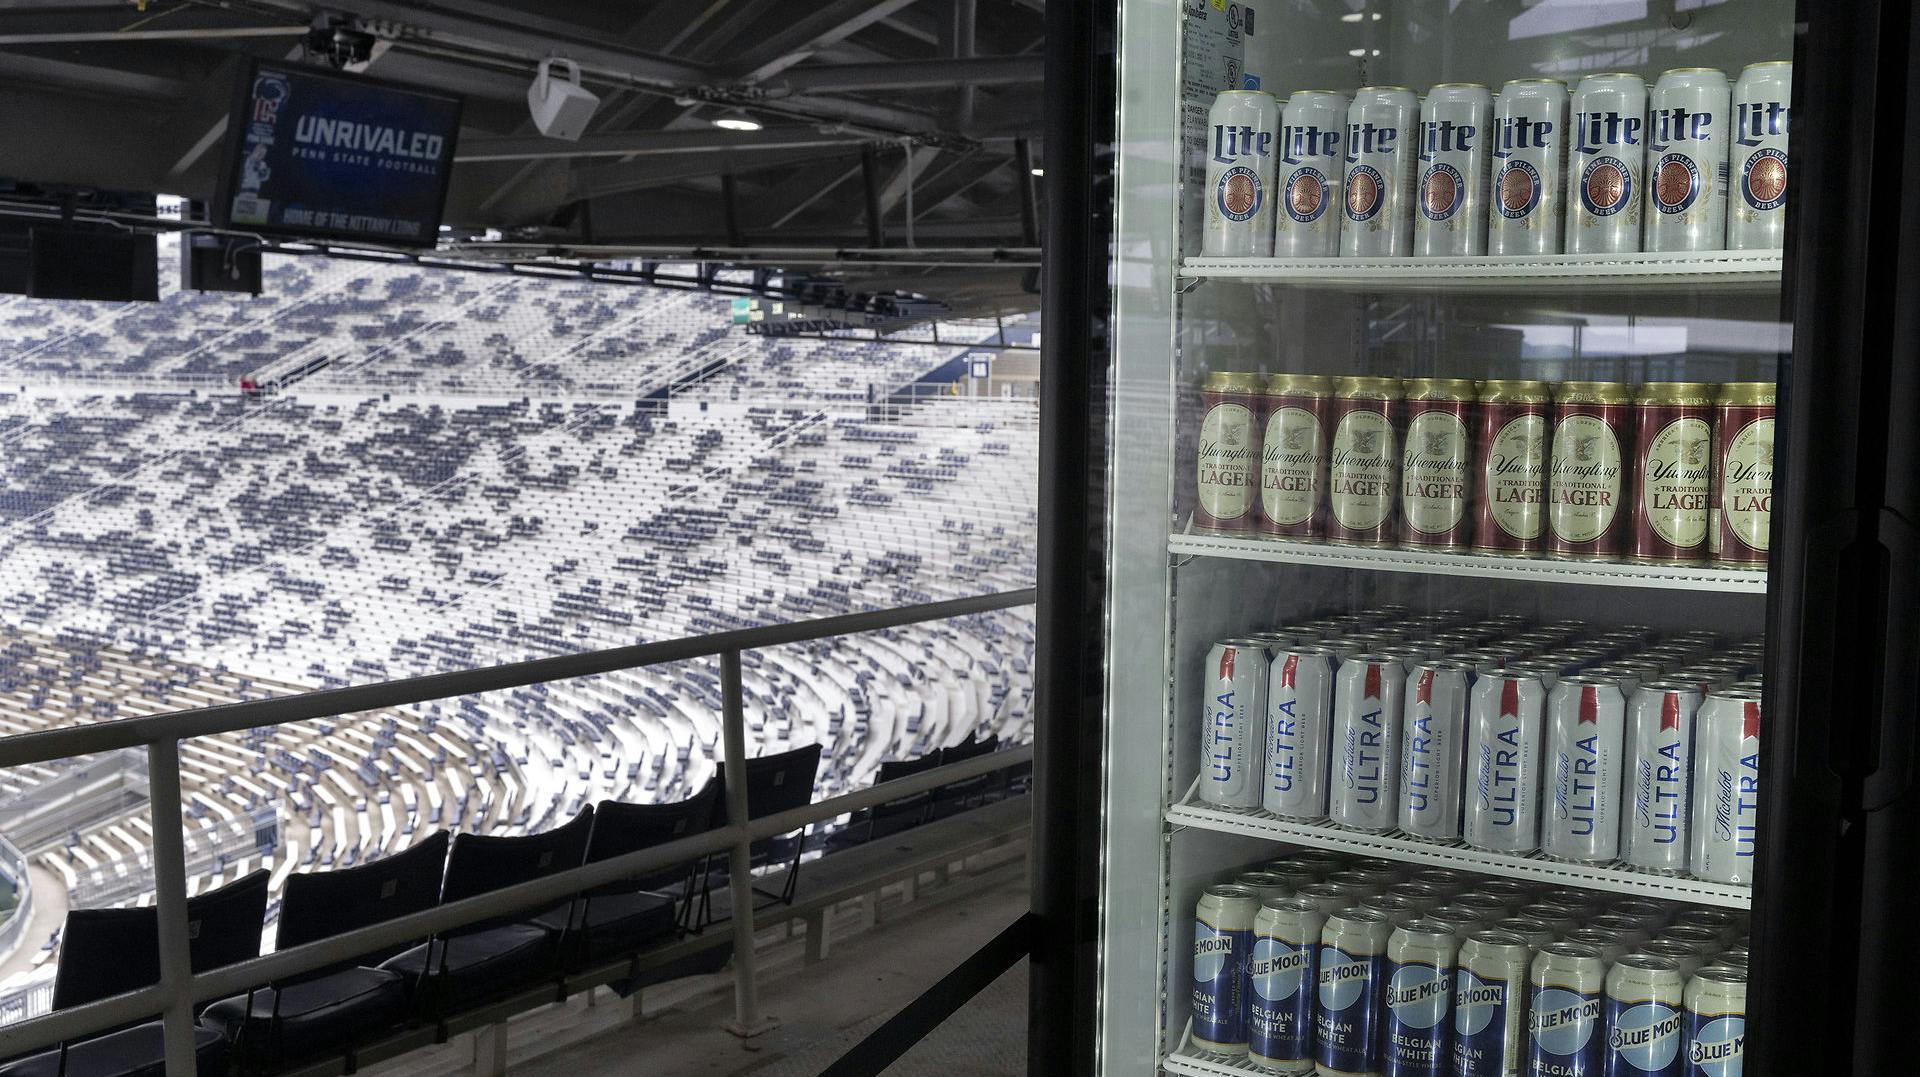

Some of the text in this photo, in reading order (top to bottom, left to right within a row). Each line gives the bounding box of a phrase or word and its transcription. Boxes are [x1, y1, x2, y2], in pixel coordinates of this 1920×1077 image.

[296, 115, 443, 159] UNRIVALED
[1419, 120, 1476, 161] Lite
[1494, 117, 1553, 158] Lite
[1575, 112, 1641, 155] Lite
[1650, 108, 1712, 152] Lite
[1213, 125, 1272, 164] Lite
[1282, 125, 1340, 165] Lite
[1346, 123, 1397, 163] Lite
[292, 147, 437, 175] PENN STATE FOOTBALL
[1515, 161, 1540, 186] PILSNER
[1587, 159, 1603, 175] FINE
[1604, 157, 1630, 184] PILSNER
[1747, 153, 1764, 170] FINE
[1438, 163, 1463, 189] PILSNER
[1505, 209, 1526, 218] BEER
[1594, 207, 1617, 215] BEER
[1662, 204, 1684, 213] BEER
[1756, 200, 1779, 209] BEER
[1200, 469, 1254, 487] LAGER
[1551, 455, 1620, 480] Yuengling
[1263, 474, 1317, 492] LAGER
[1333, 479, 1391, 497] LAGER
[1405, 482, 1464, 499] LAGER
[1551, 489, 1611, 506] LAGER
[1213, 690, 1235, 781] ULTRA
[1274, 698, 1297, 791] ULTRA
[1357, 707, 1382, 804] ULTRA
[1409, 714, 1432, 811] ULTRA
[1492, 726, 1519, 826] ULTRA
[1556, 752, 1569, 820] Michelob
[1571, 735, 1598, 835] ULTRA
[1636, 758, 1651, 828] Michelob
[1653, 741, 1680, 844] ULTRA
[1715, 768, 1732, 842] Michelob
[1199, 938, 1231, 953] MOON
[1271, 953, 1309, 972] MOON
[1332, 964, 1369, 981] MOON
[1386, 979, 1448, 1005] BLUE MOO
[1464, 989, 1500, 1005] MOON
[1252, 1004, 1293, 1022] BELGIAN
[1253, 1017, 1286, 1033] WHITE
[1560, 1002, 1599, 1025] MOON
[1391, 1033, 1441, 1049] BELGIAN
[1610, 1016, 1680, 1048] BLUE MOO
[1396, 1046, 1434, 1061] WHITE
[1690, 1041, 1731, 1063] BLUE
[1532, 1060, 1584, 1077] BELGIAN
